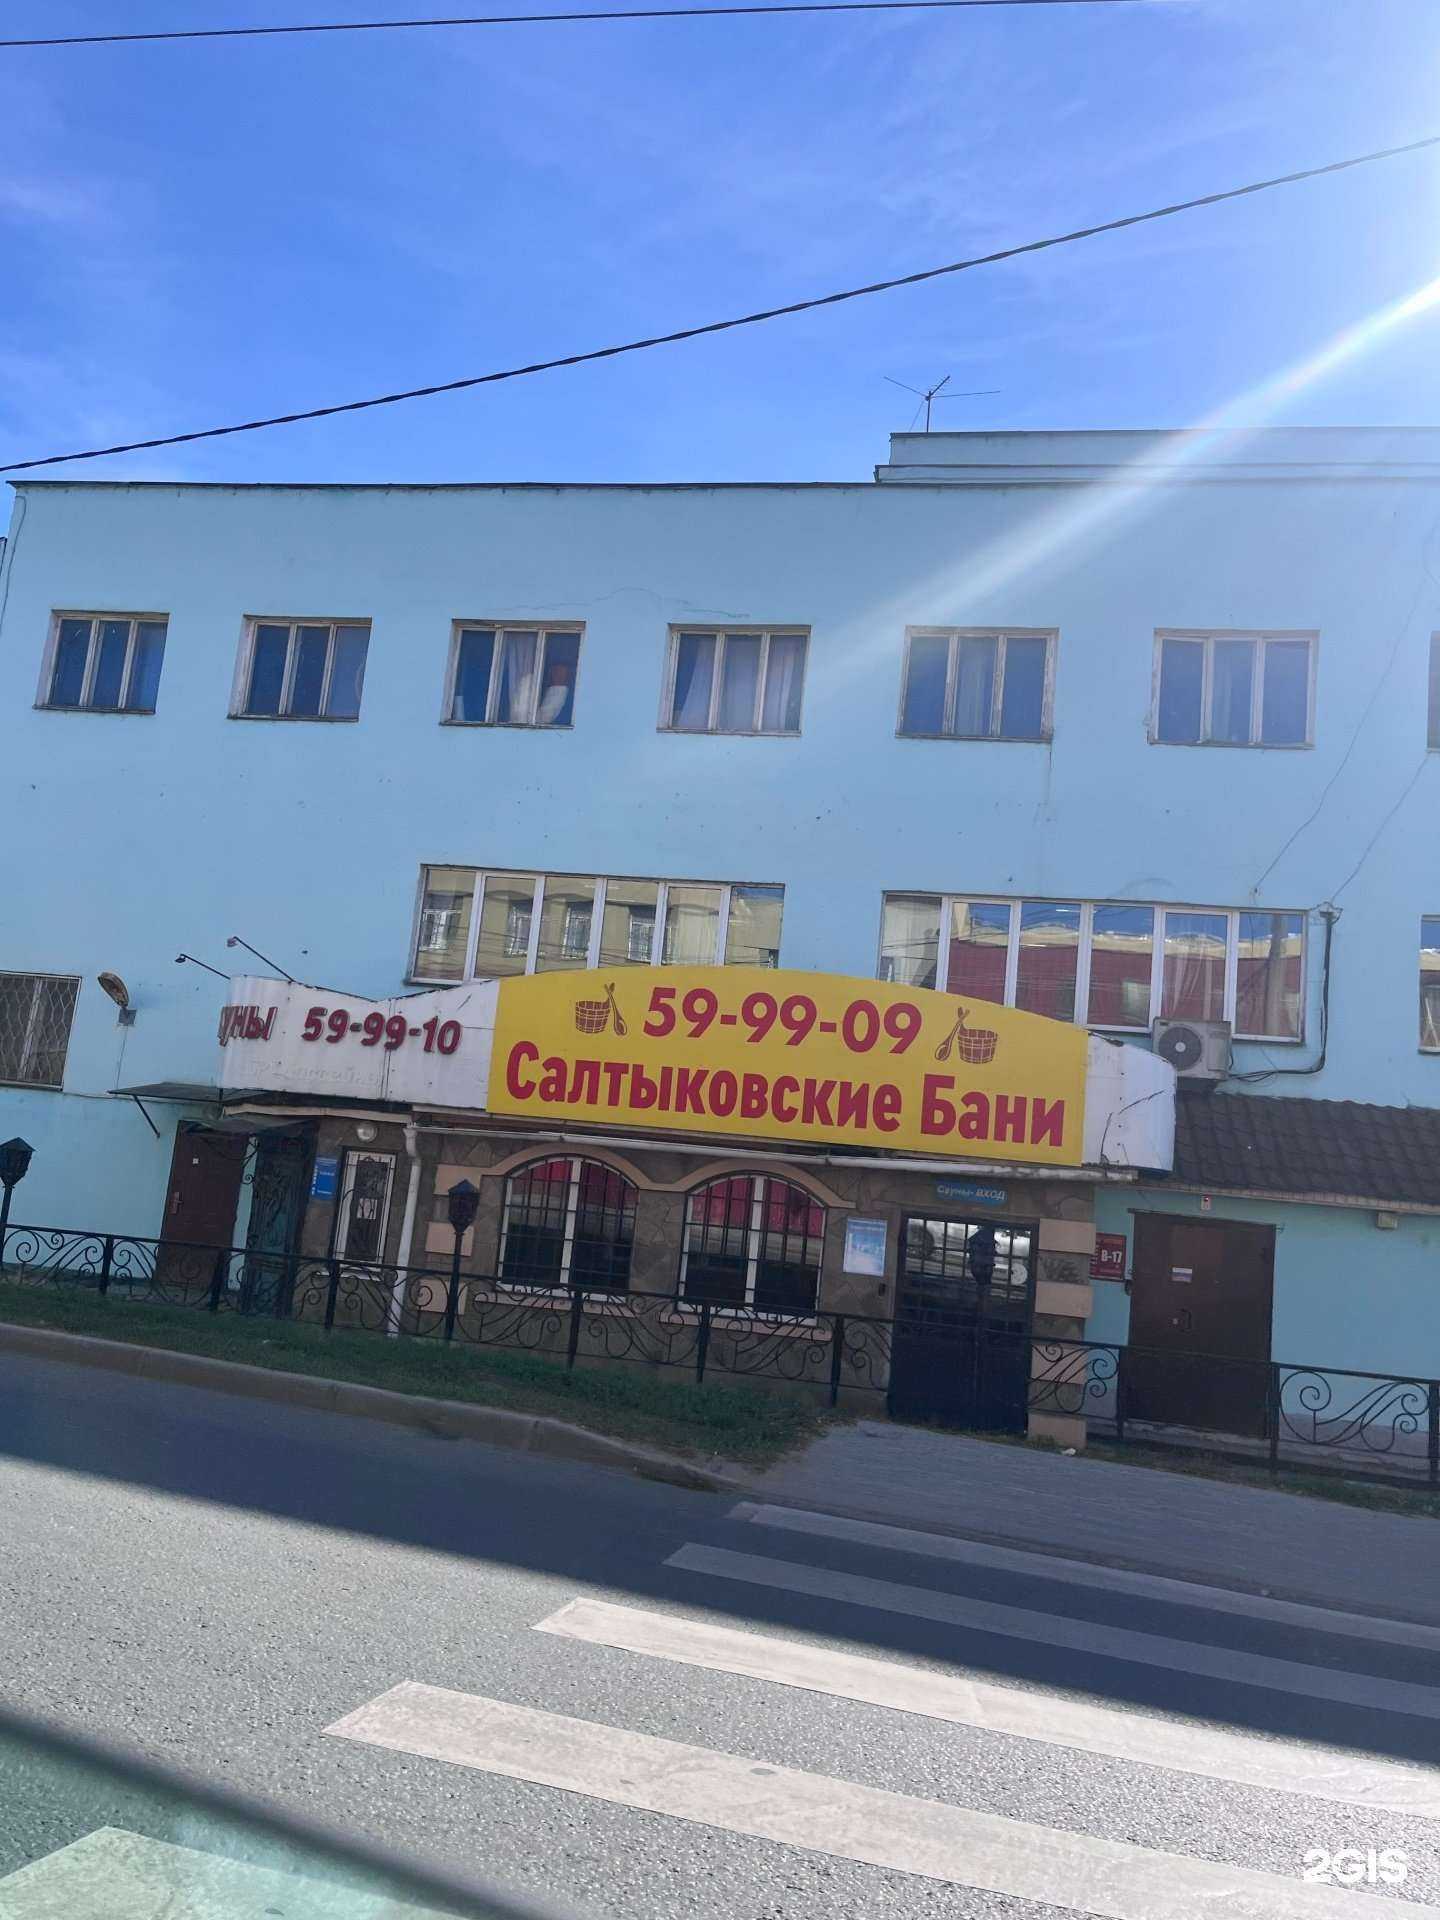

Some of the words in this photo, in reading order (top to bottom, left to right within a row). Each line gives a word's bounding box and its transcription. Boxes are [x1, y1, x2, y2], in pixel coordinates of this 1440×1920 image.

[301, 1005, 462, 1055] 59-99-10
[643, 986, 923, 1055] 59-99-09
[505, 1040, 903, 1133] Салтыковские
[920, 1073, 1065, 1148] Бани
